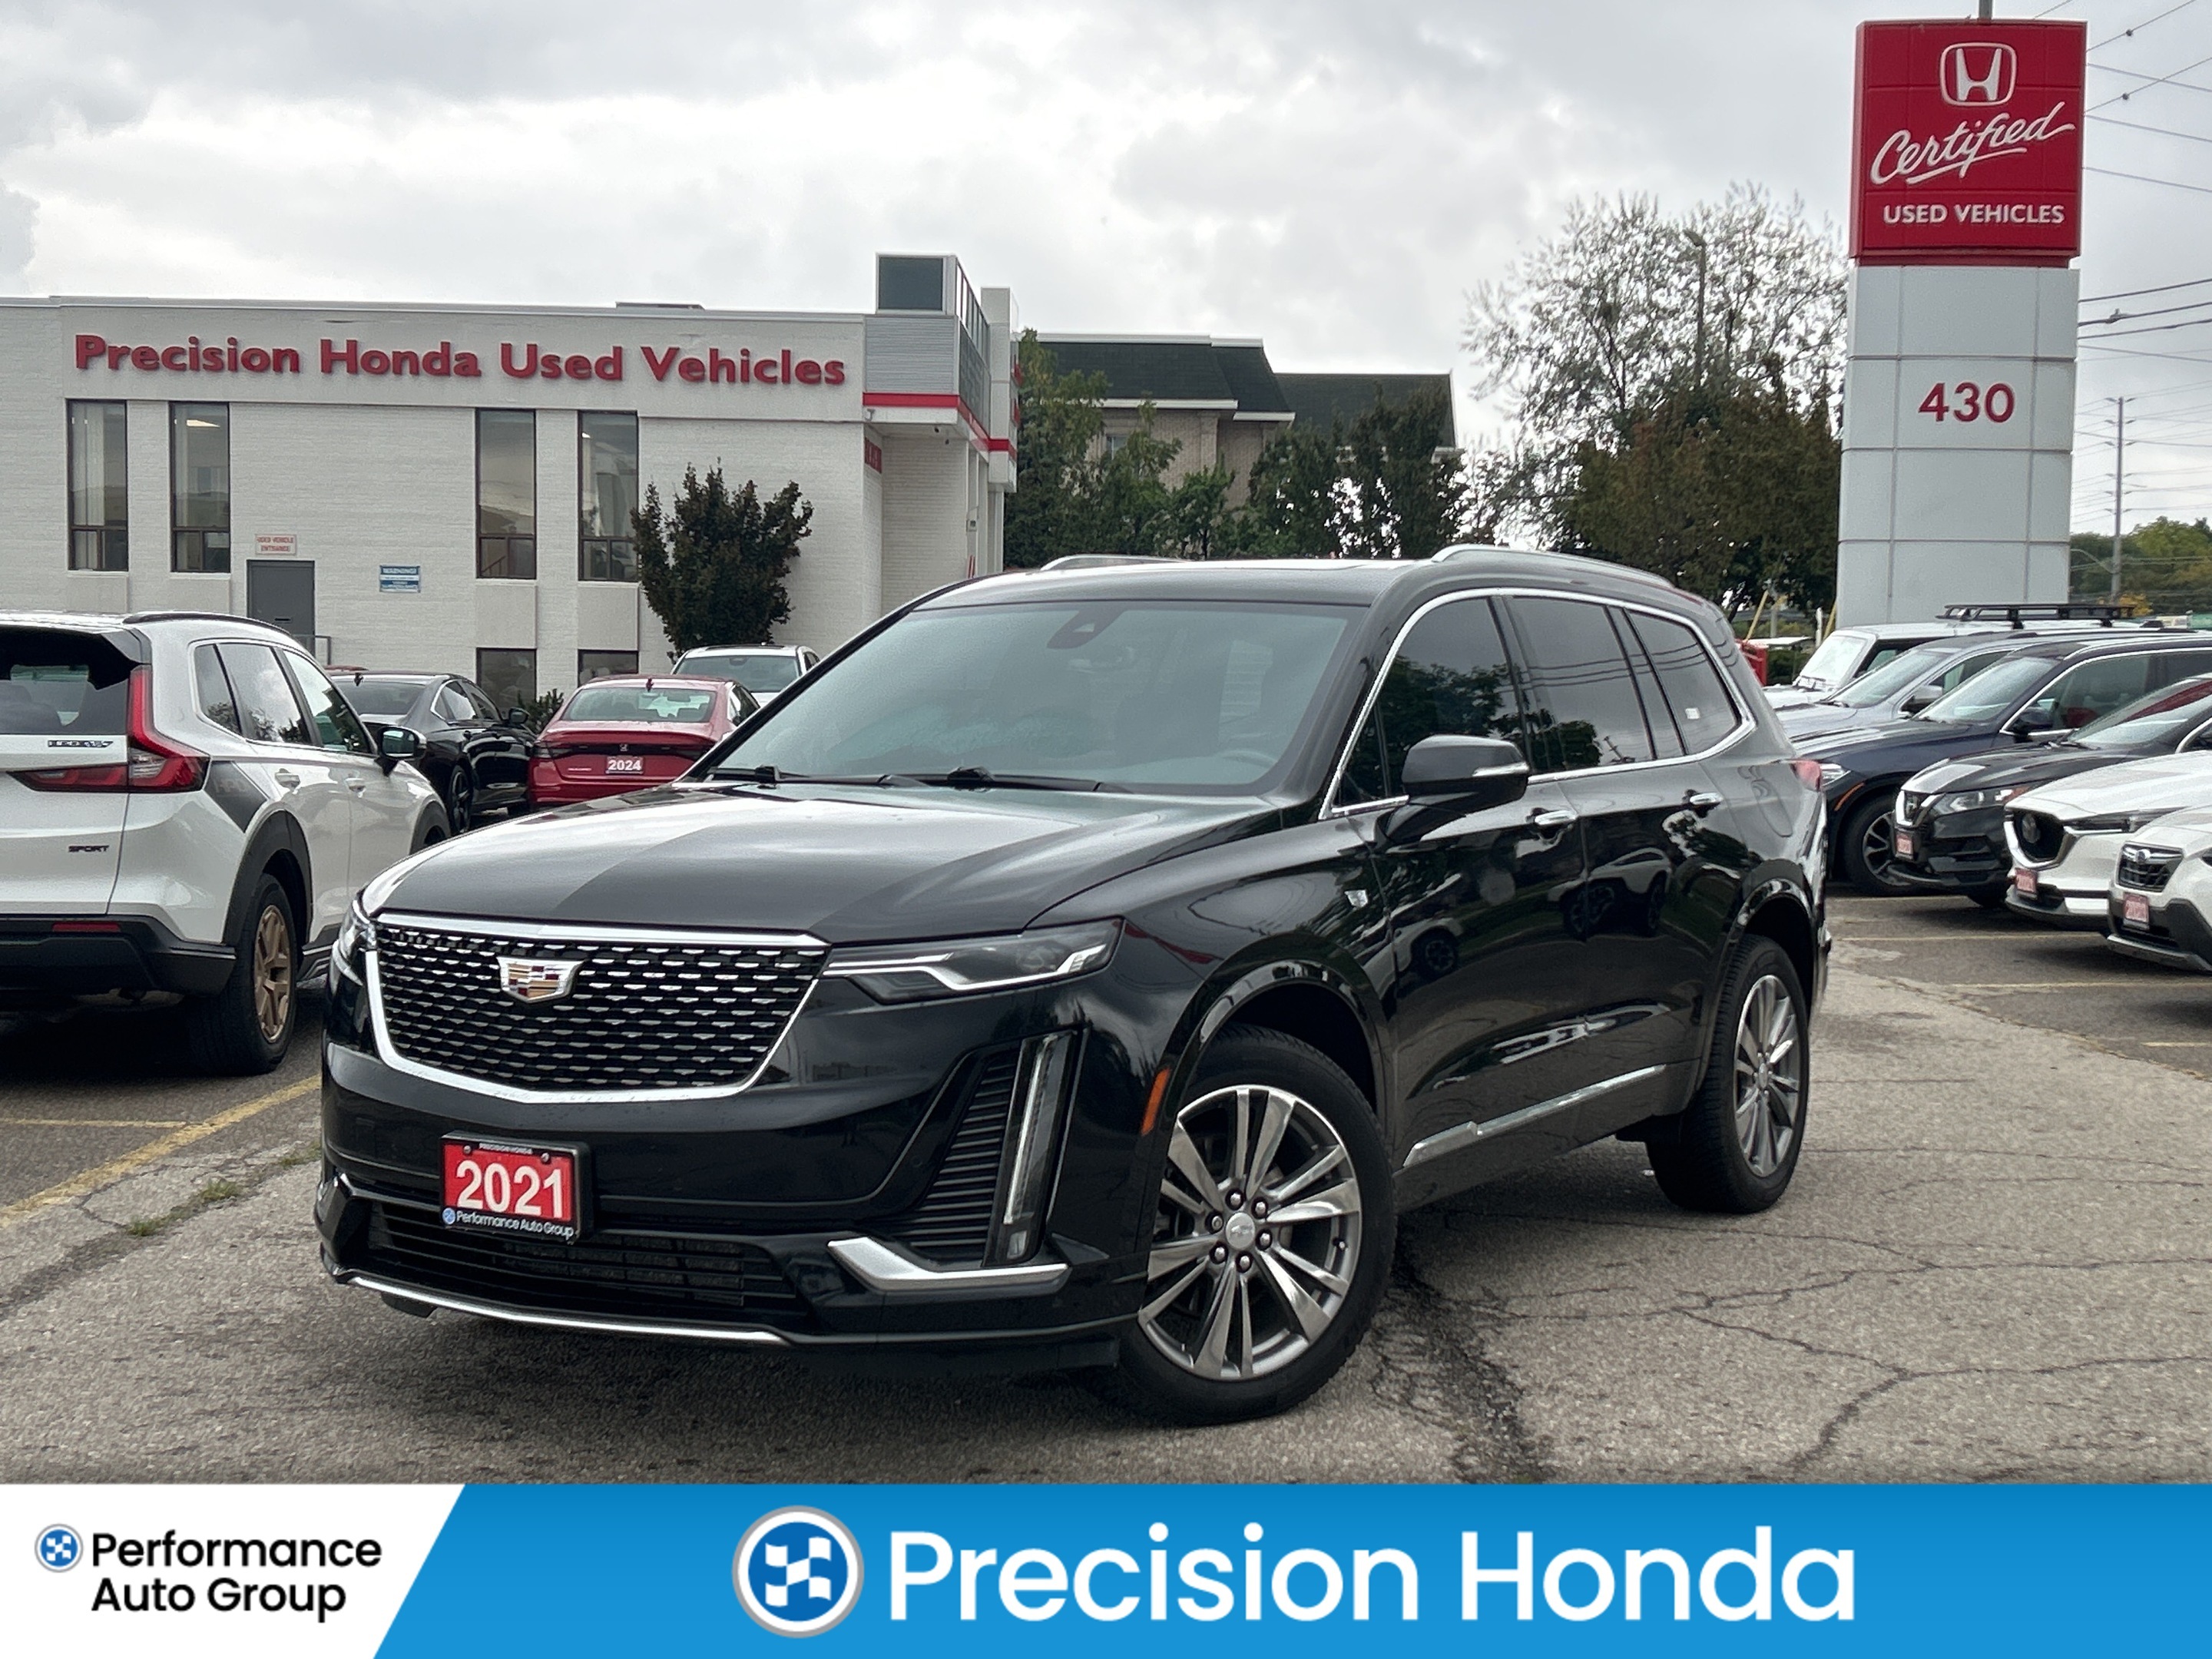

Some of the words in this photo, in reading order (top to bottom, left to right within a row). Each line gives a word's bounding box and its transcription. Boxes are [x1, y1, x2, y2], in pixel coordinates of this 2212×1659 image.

[1870, 101, 2076, 184] Certified
[1883, 204, 1948, 224] USED
[1954, 204, 2065, 224] VEHICLES
[75, 334, 300, 374] Precision
[320, 339, 482, 377] Honda
[500, 343, 623, 381] Used
[641, 346, 846, 386] Vehicles
[1918, 382, 2015, 423] 430
[608, 759, 643, 771] 2024
[455, 1159, 563, 1219] 2021
[455, 1210, 520, 1230] Performance
[519, 1218, 543, 1233] Auto
[544, 1222, 575, 1241] Group
